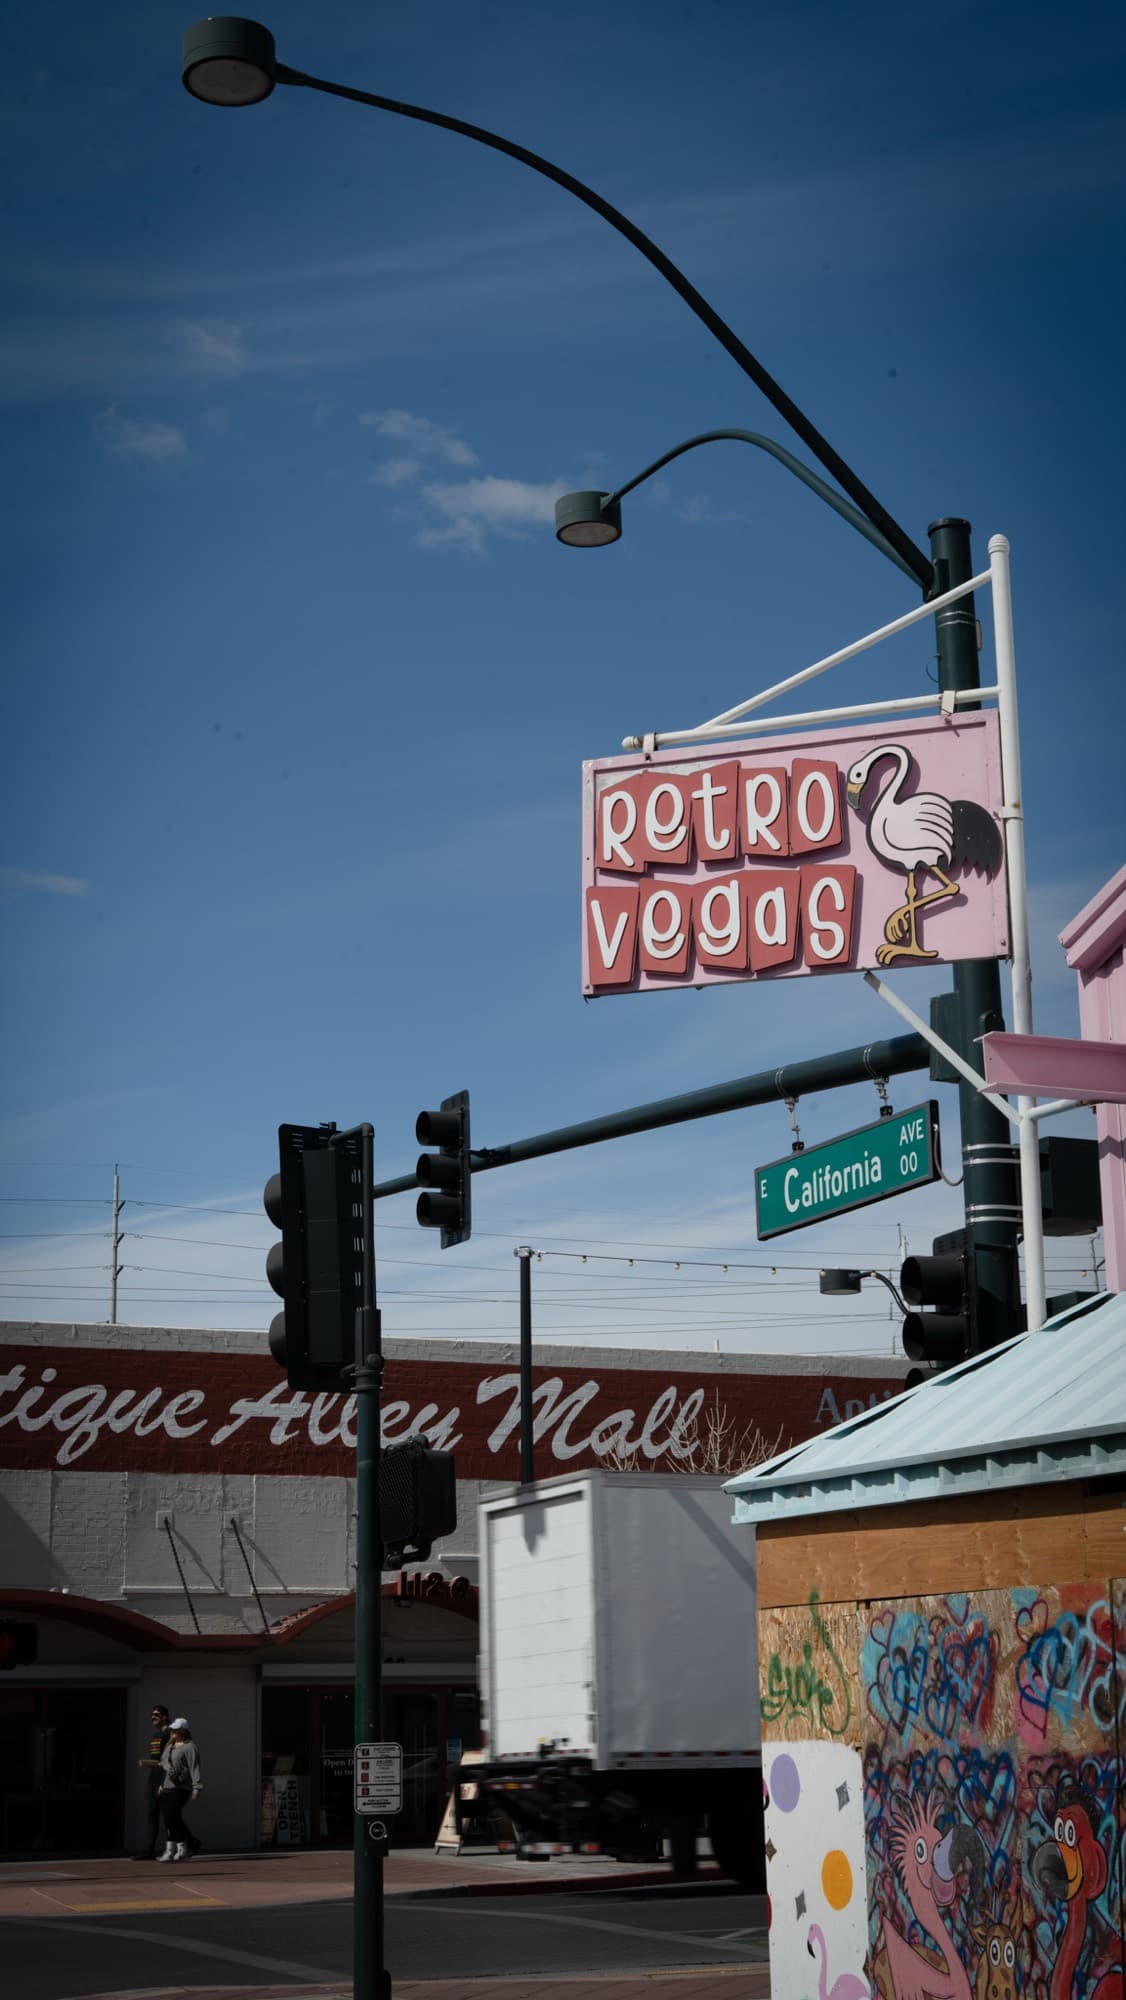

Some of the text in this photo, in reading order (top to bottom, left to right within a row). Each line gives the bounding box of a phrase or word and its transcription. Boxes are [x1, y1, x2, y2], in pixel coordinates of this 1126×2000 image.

[760, 1118, 925, 1213] E California AVE
[476, 1373, 705, 1460] Mall
[278, 1791, 289, 1830] OPEN
